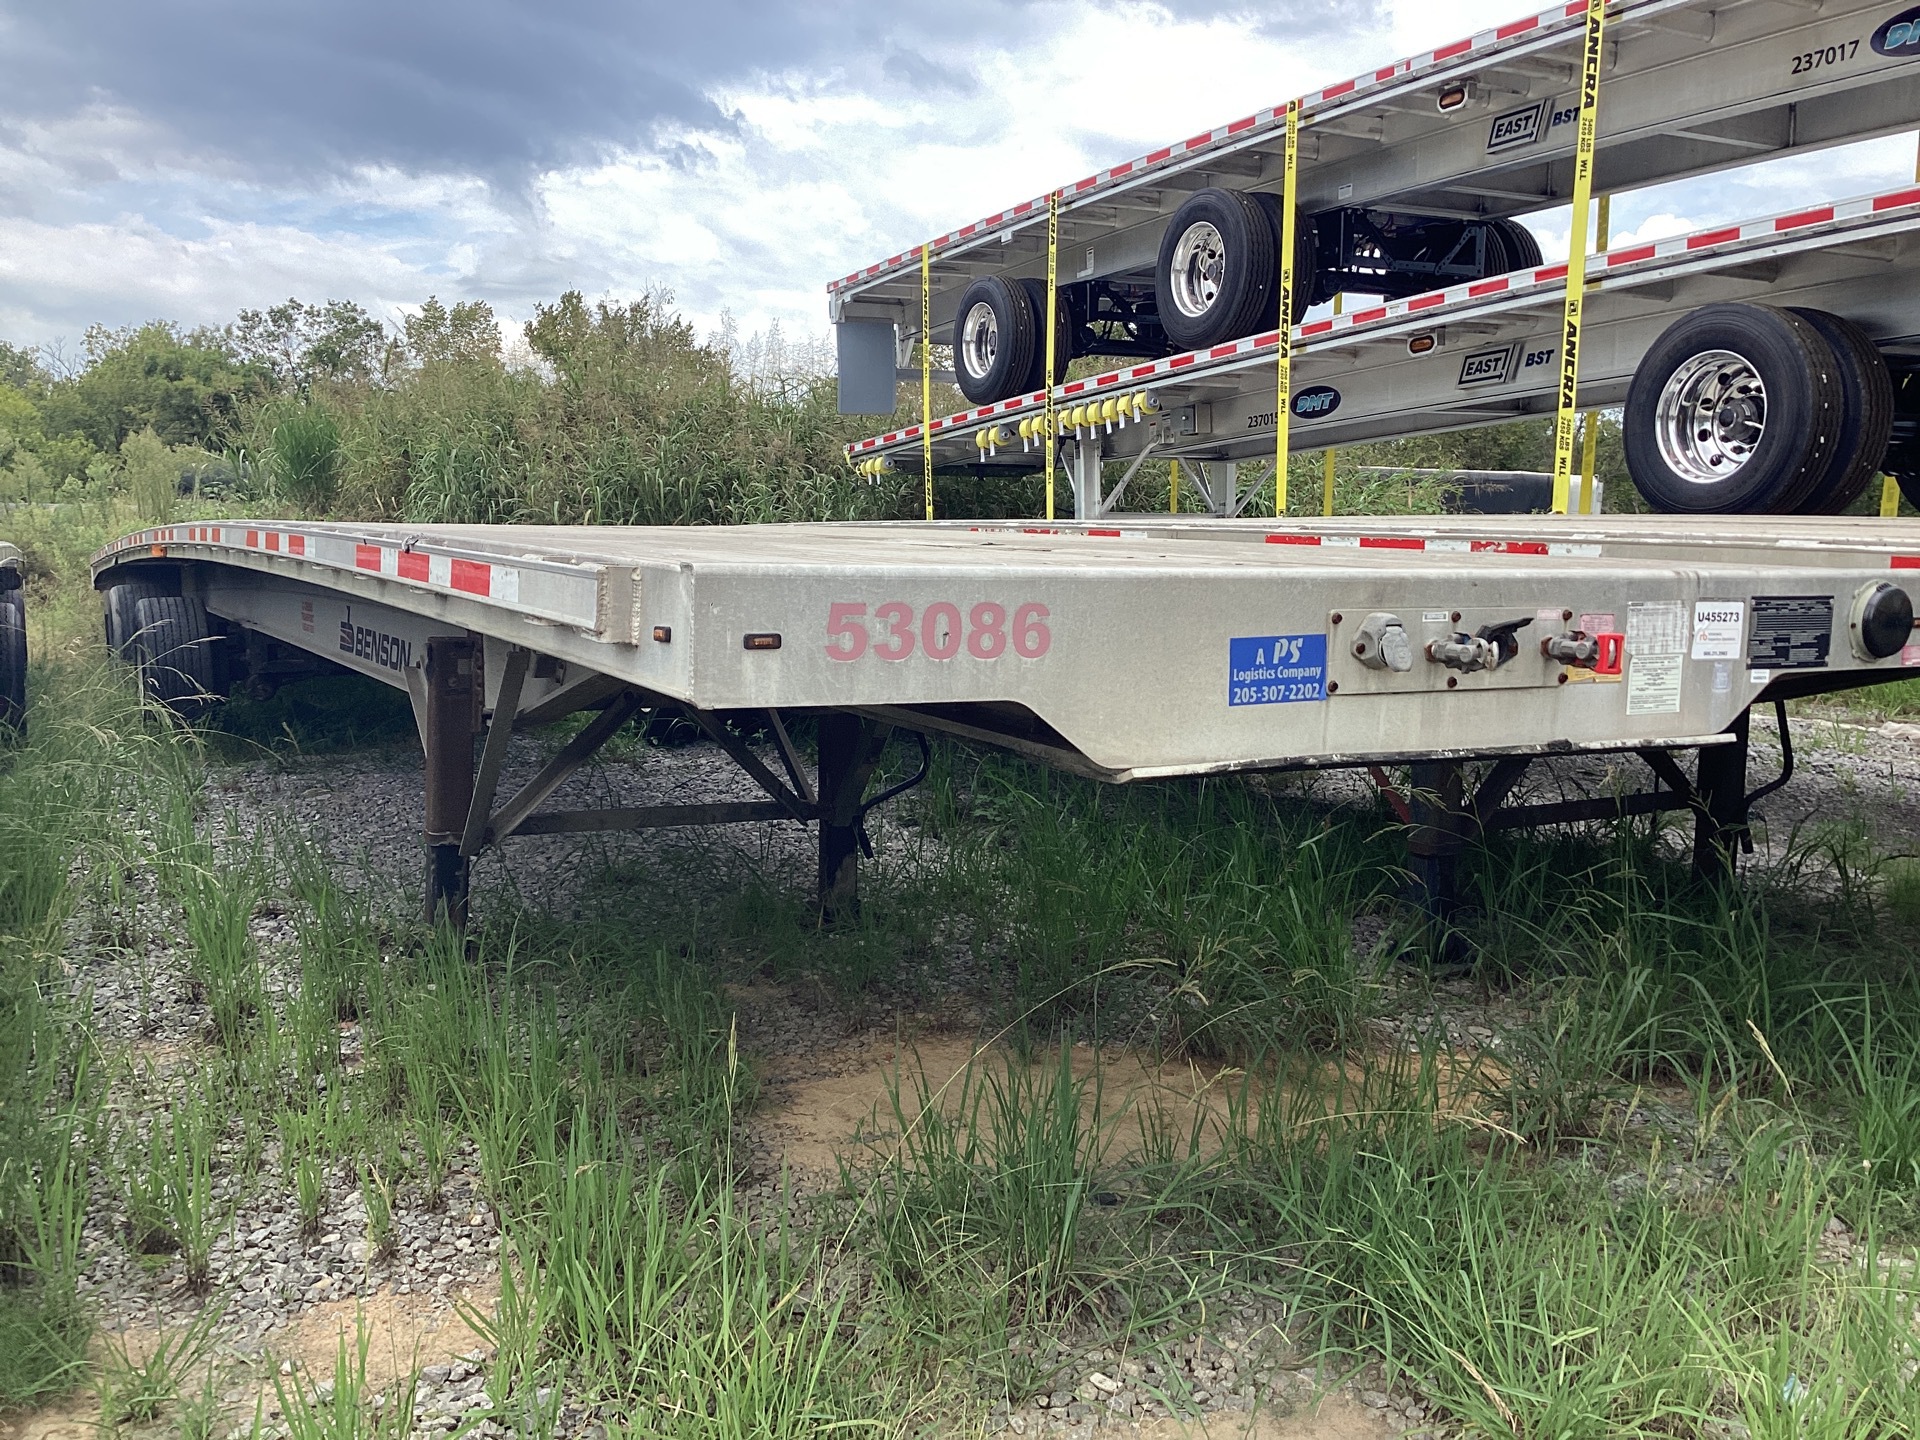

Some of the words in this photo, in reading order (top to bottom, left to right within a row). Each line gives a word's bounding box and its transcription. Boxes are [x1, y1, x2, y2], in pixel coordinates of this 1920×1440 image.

[1584, 16, 1601, 109] ANCRA
[1791, 39, 1859, 74] 237017
[1495, 114, 1533, 139] EAST
[1552, 106, 1580, 127] BST
[1580, 160, 1588, 181] WLL
[1280, 285, 1290, 359] ANCRA
[1465, 357, 1502, 376] EAST
[1525, 349, 1555, 367] BST
[1562, 319, 1577, 409] ANCRA
[1296, 392, 1335, 413] DMT
[1247, 412, 1279, 428] 237015
[1559, 456, 1567, 477] WLL
[1698, 611, 1740, 623] U455273
[824, 601, 1051, 662] 53086
[355, 626, 411, 673] BENSON
[1255, 648, 1265, 665] A
[1272, 638, 1304, 664] PS
[1233, 666, 1276, 684] Logistics
[1277, 665, 1322, 680] Company
[1233, 683, 1320, 704] 205-307-2202
